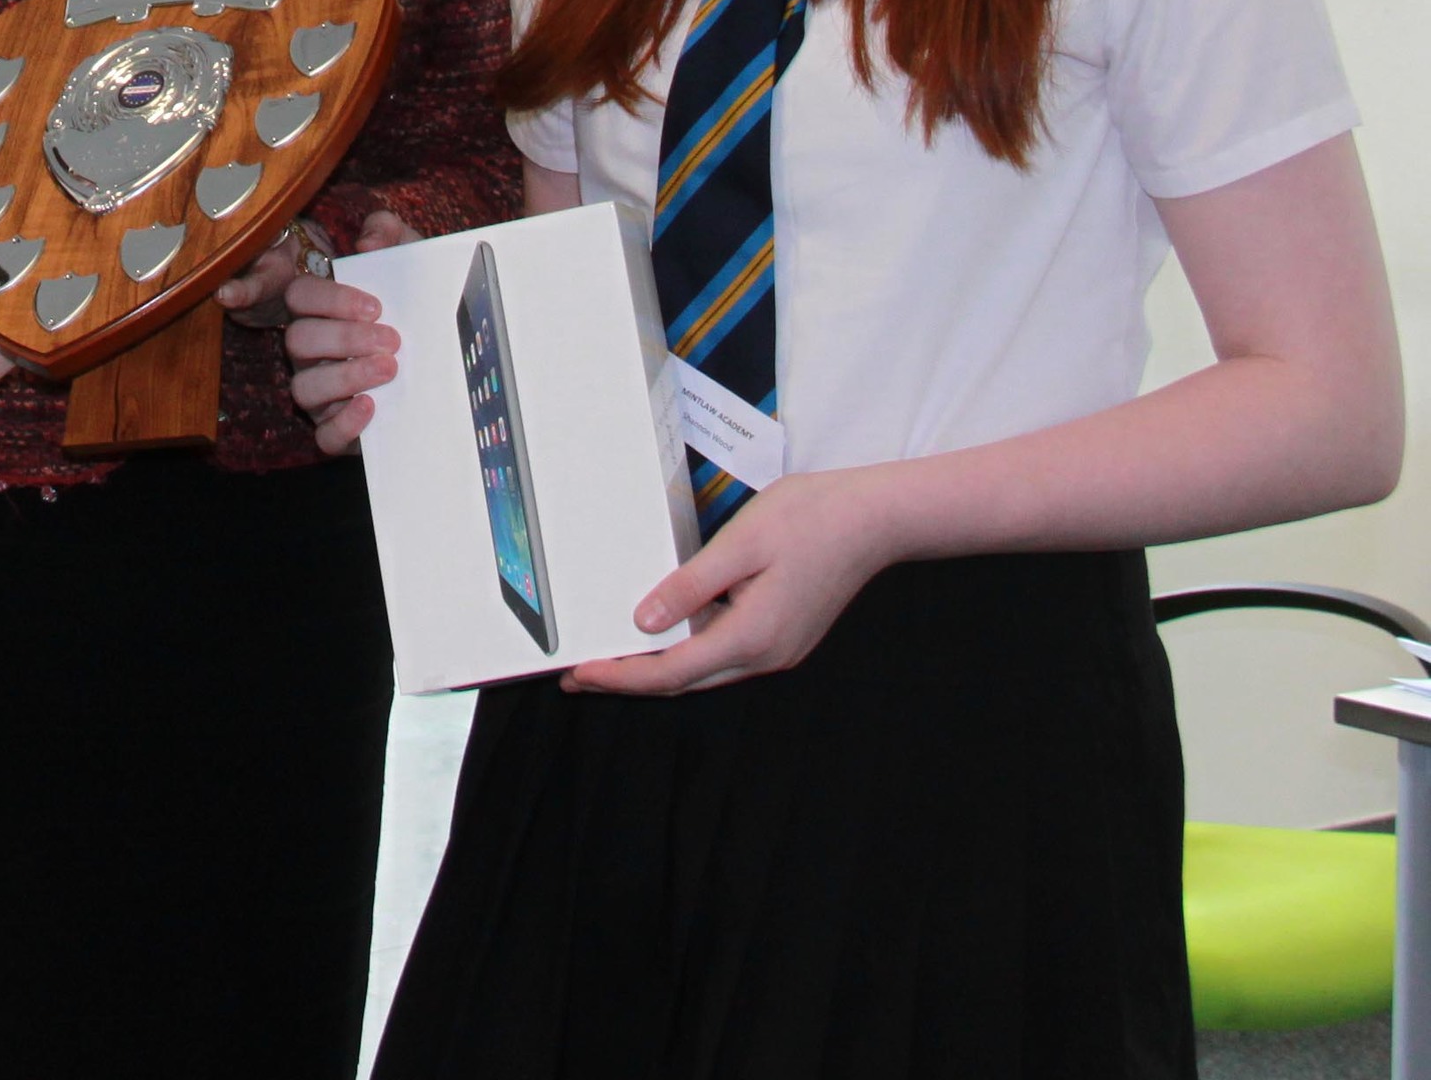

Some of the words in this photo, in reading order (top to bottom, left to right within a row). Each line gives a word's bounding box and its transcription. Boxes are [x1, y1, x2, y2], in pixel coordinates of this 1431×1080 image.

[682, 387, 717, 415] MINTLAW
[717, 412, 754, 440] ACADEMY
[712, 432, 733, 452] Wood
